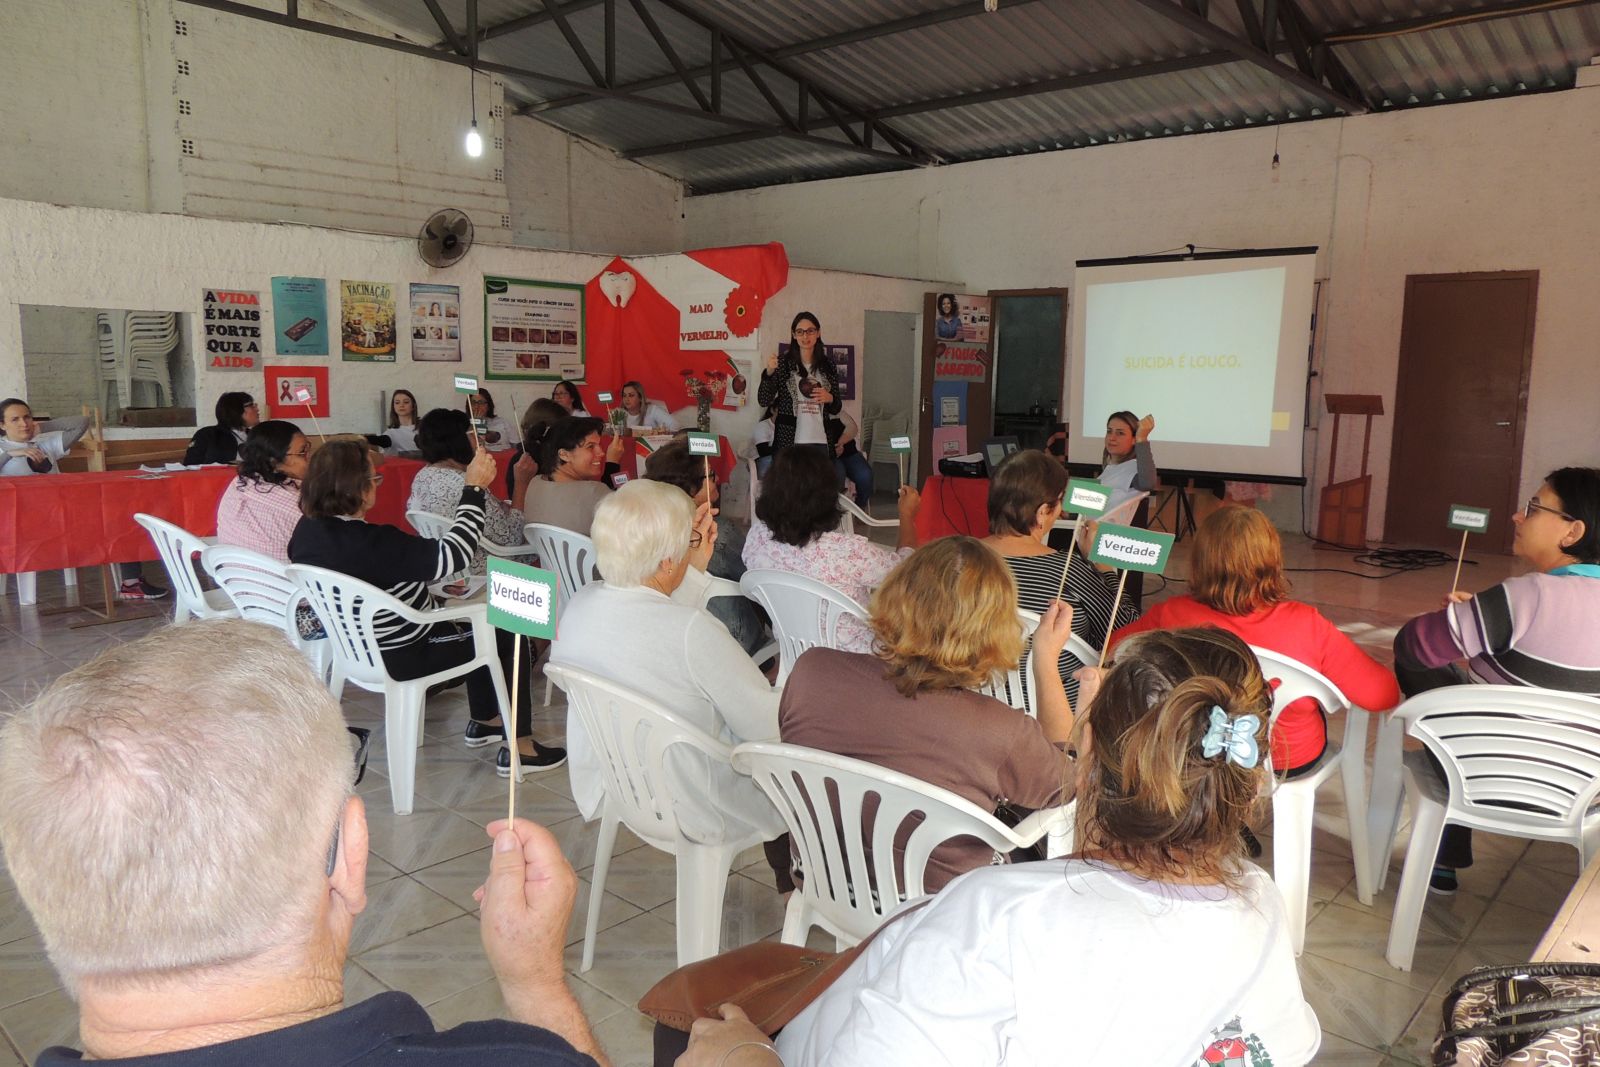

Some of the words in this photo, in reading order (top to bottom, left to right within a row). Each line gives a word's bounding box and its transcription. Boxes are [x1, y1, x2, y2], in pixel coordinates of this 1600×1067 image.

[204, 291, 216, 302] A
[216, 291, 260, 305] VIDA
[347, 284, 391, 299] VACINAÇÃO
[204, 305, 216, 320] É
[218, 308, 260, 320] MAIS
[689, 303, 713, 314] MAIO
[205, 324, 260, 337] FORTE
[680, 330, 729, 342] VERMELHO
[207, 339, 242, 353] QUE
[246, 341, 259, 352] A
[944, 347, 977, 361] FIQUE
[1124, 356, 1174, 369] SUICIDA
[1178, 352, 1185, 369] É
[1189, 354, 1241, 369] LOUCO.
[211, 356, 254, 368] AIDS
[936, 362, 984, 377] SABENDO
[691, 440, 714, 449] Verdade
[1073, 491, 1103, 504] Verdade
[1455, 514, 1482, 522] Verdade
[1104, 539, 1156, 558] Verdade
[493, 580, 543, 607] Verdade
